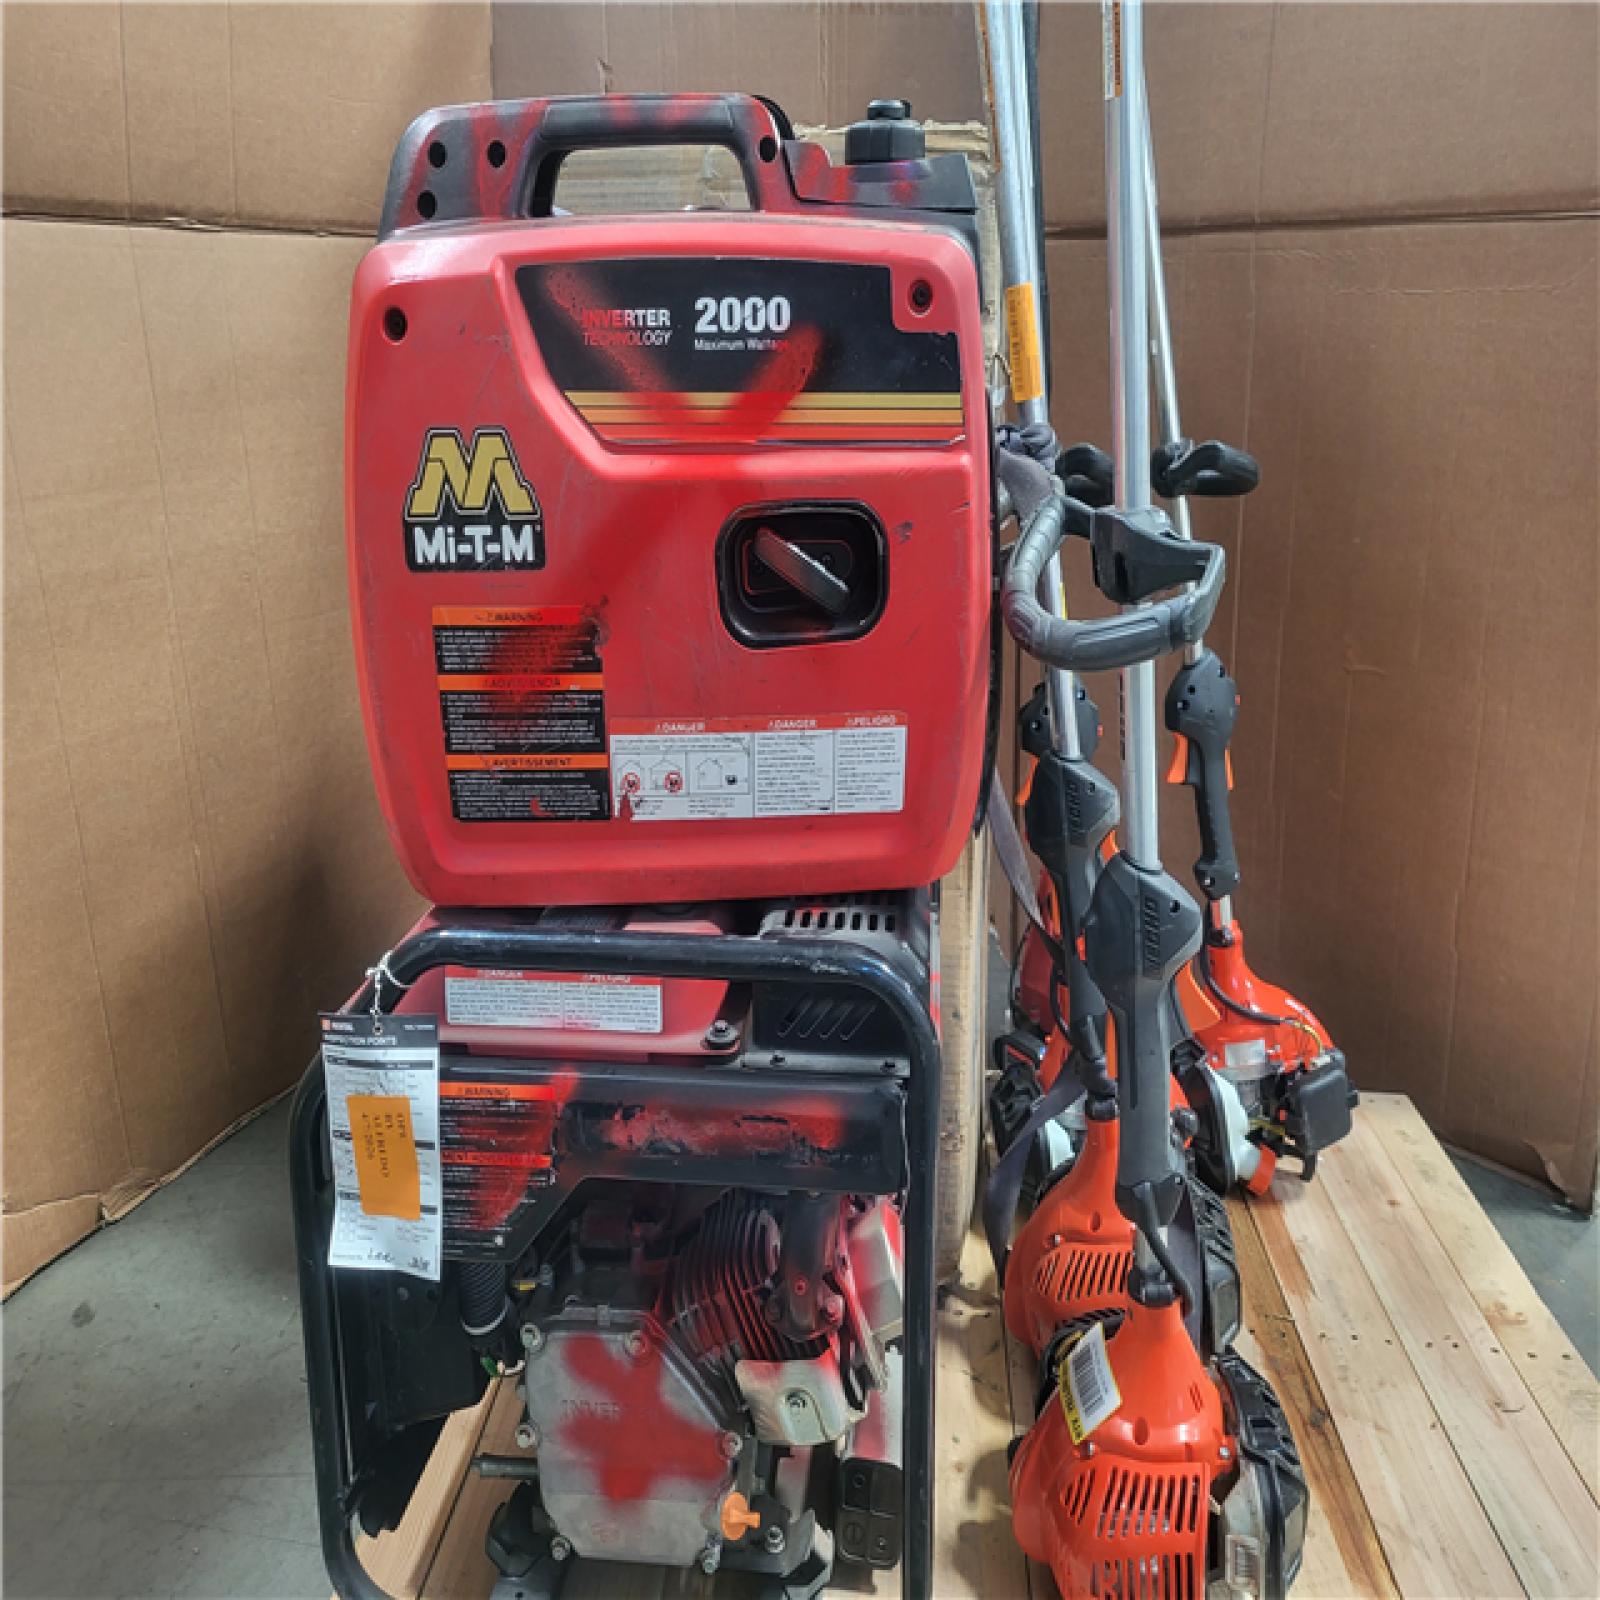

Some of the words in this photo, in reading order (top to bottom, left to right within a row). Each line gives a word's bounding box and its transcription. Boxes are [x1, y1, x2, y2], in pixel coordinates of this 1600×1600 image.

[582, 309, 671, 326] INVERTER
[695, 296, 791, 333] 2000
[584, 330, 673, 346] TECHNOLOGY
[695, 339, 744, 350] Maximum
[414, 525, 535, 563] Mi-T-M
[774, 719, 817, 729] DANGER
[854, 715, 897, 726] PELIGRO
